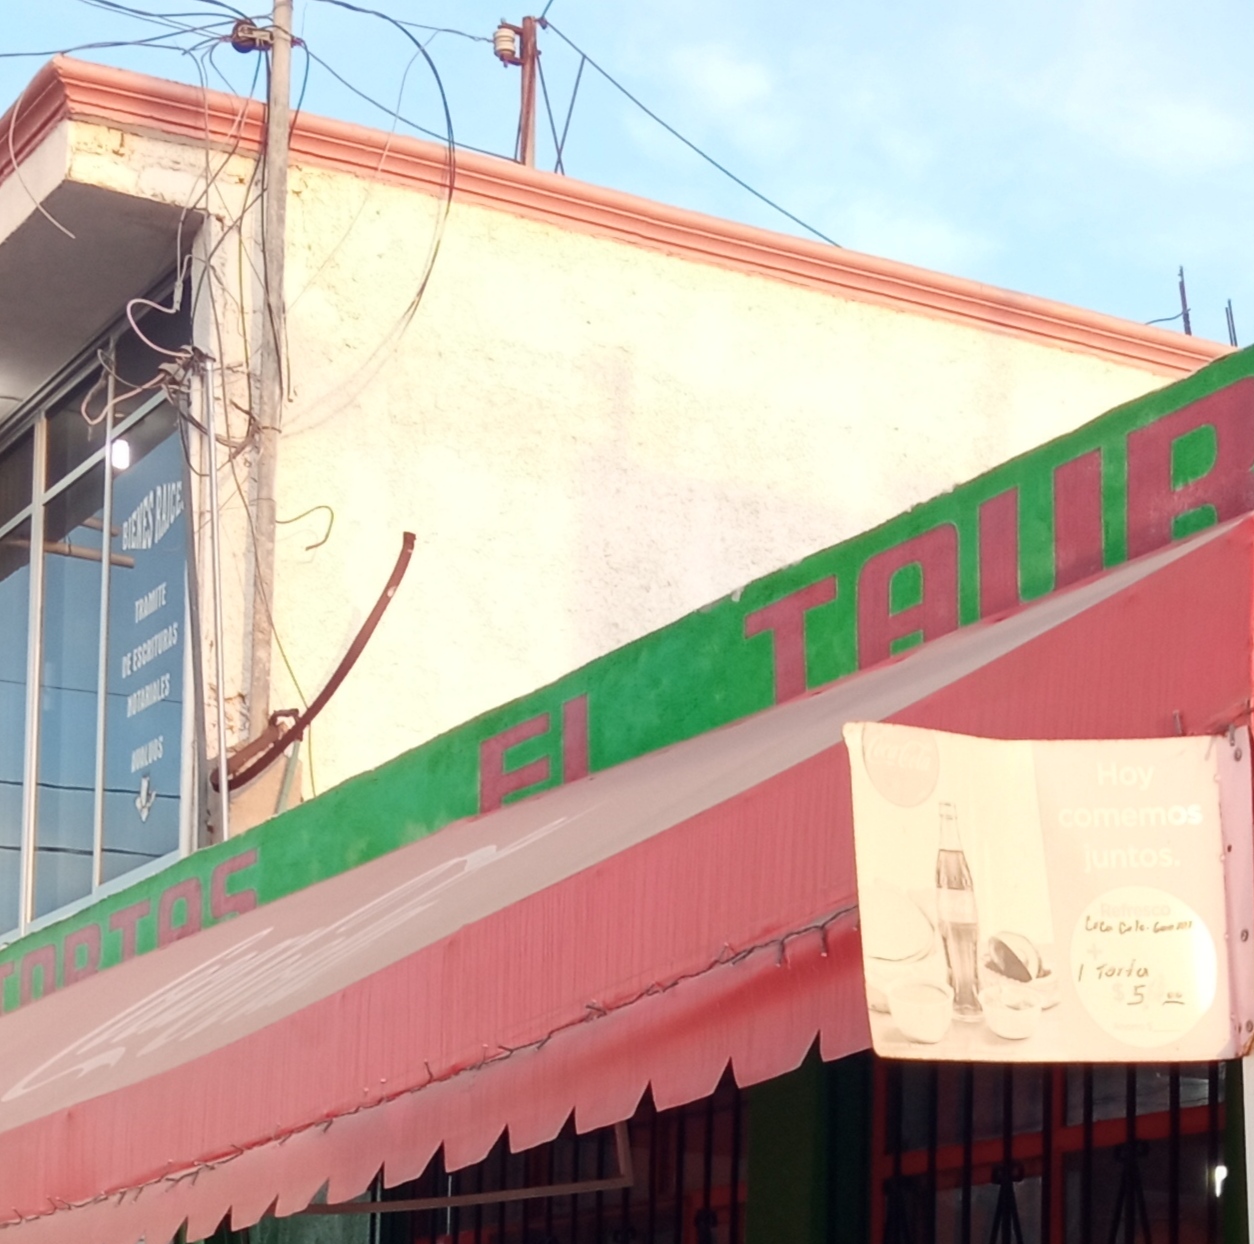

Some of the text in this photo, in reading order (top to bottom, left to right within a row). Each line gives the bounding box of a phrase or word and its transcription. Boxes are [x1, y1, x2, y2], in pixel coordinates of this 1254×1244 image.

[1096, 761, 1156, 792] Hoy
[1057, 803, 1204, 829] comemos
[1083, 842, 1181, 874] juntos.
